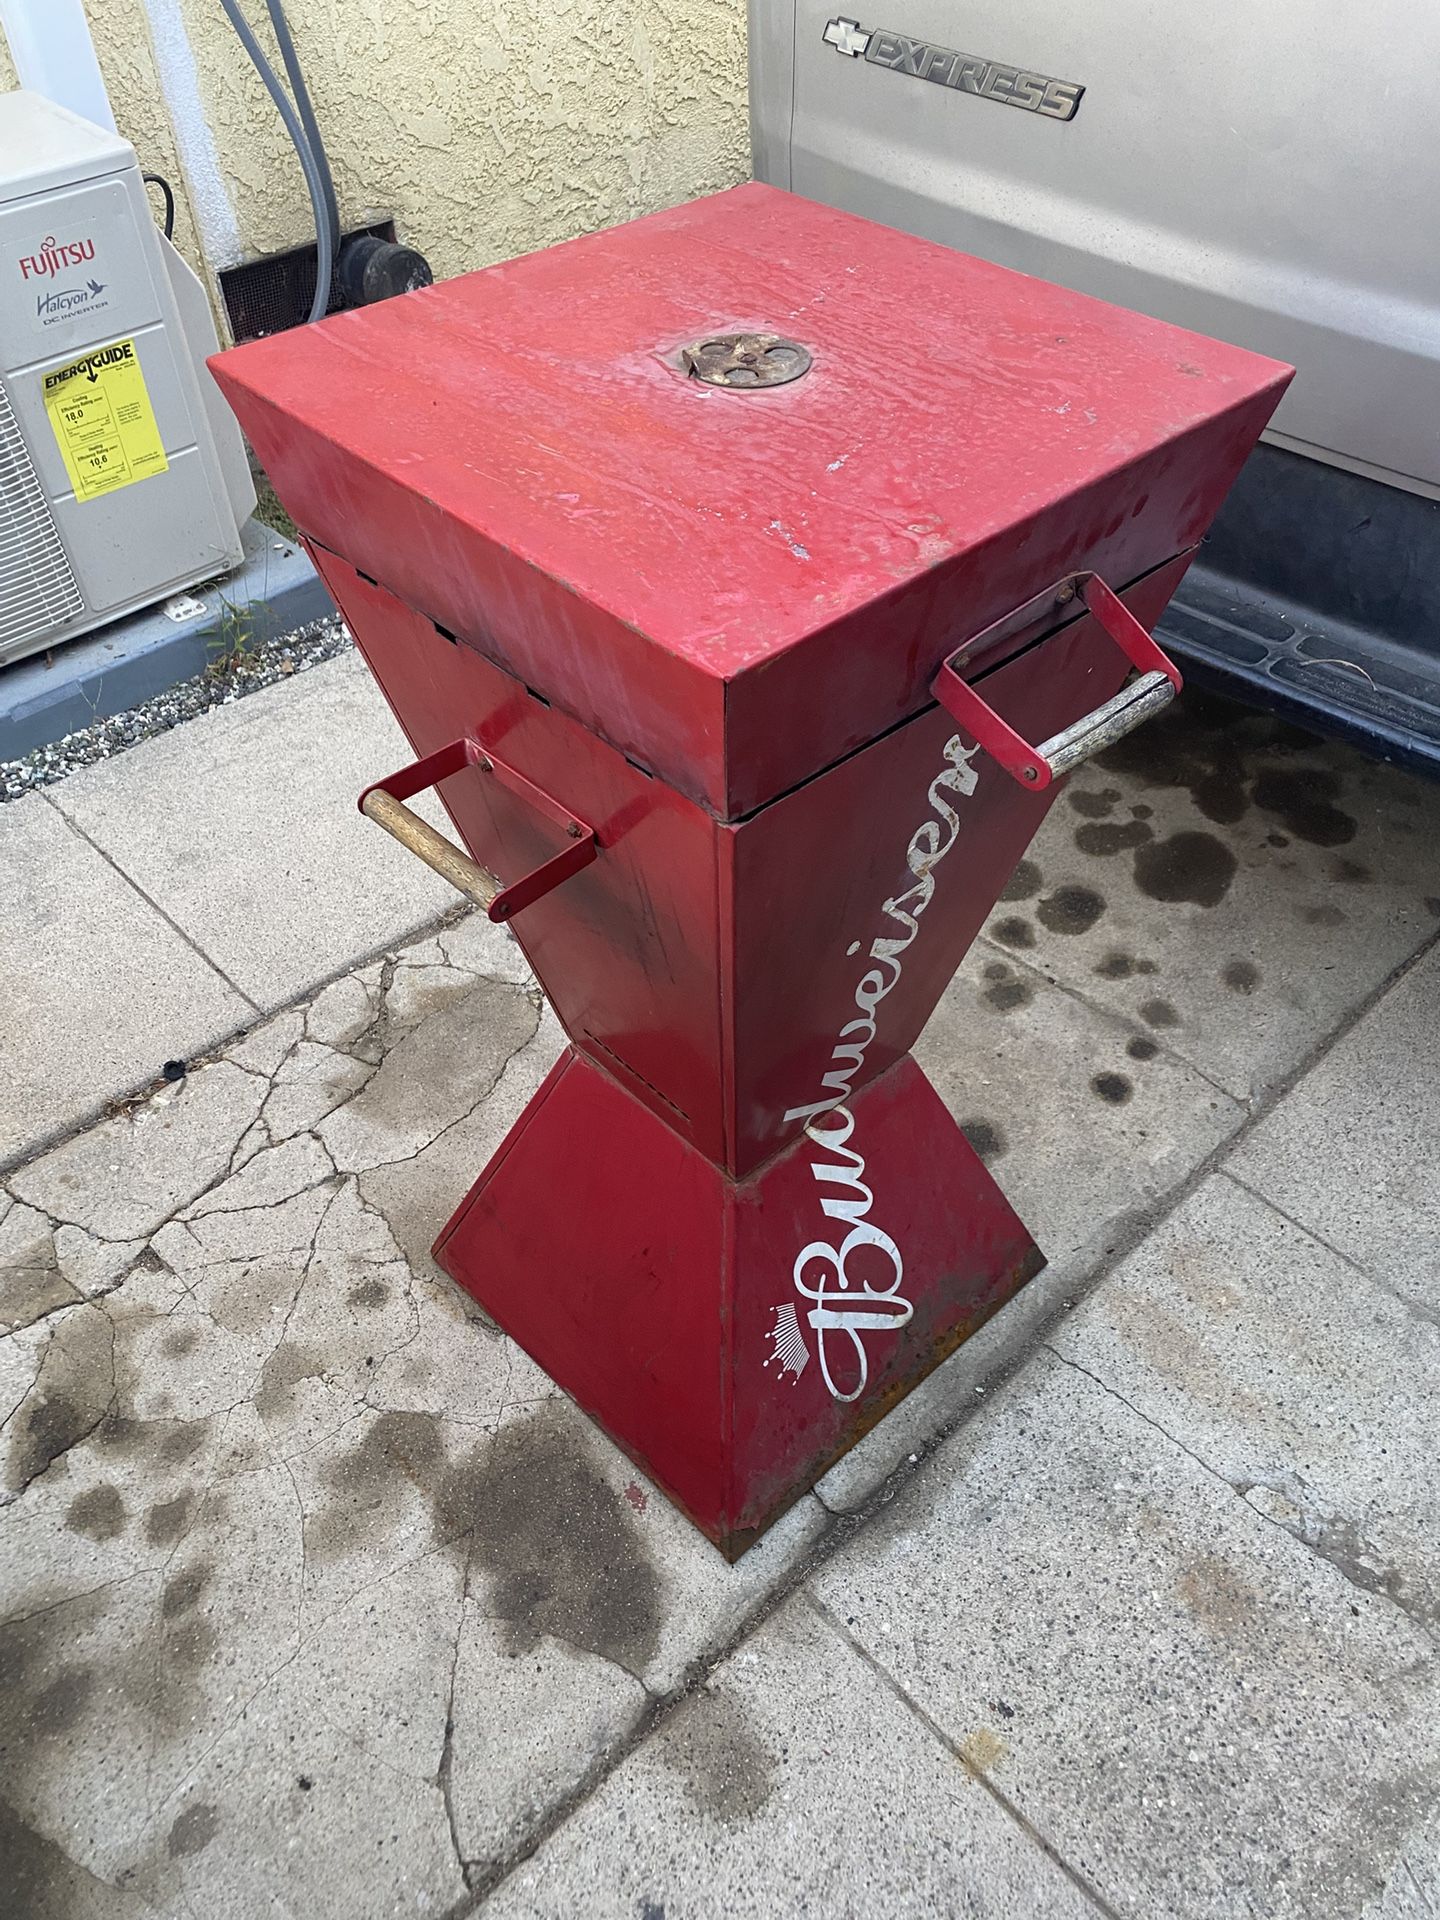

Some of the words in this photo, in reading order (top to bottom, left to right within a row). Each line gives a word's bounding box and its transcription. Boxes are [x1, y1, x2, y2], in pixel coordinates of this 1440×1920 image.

[866, 30, 1084, 121] EXPRESS
[19, 237, 95, 279] FUJITSU
[37, 289, 88, 316] Halcyon
[43, 316, 60, 326] DC
[61, 301, 109, 320] INVERTER
[65, 409, 84, 422] 18.0
[89, 454, 108, 467] 10.6
[783, 734, 981, 1403] Budweiser
